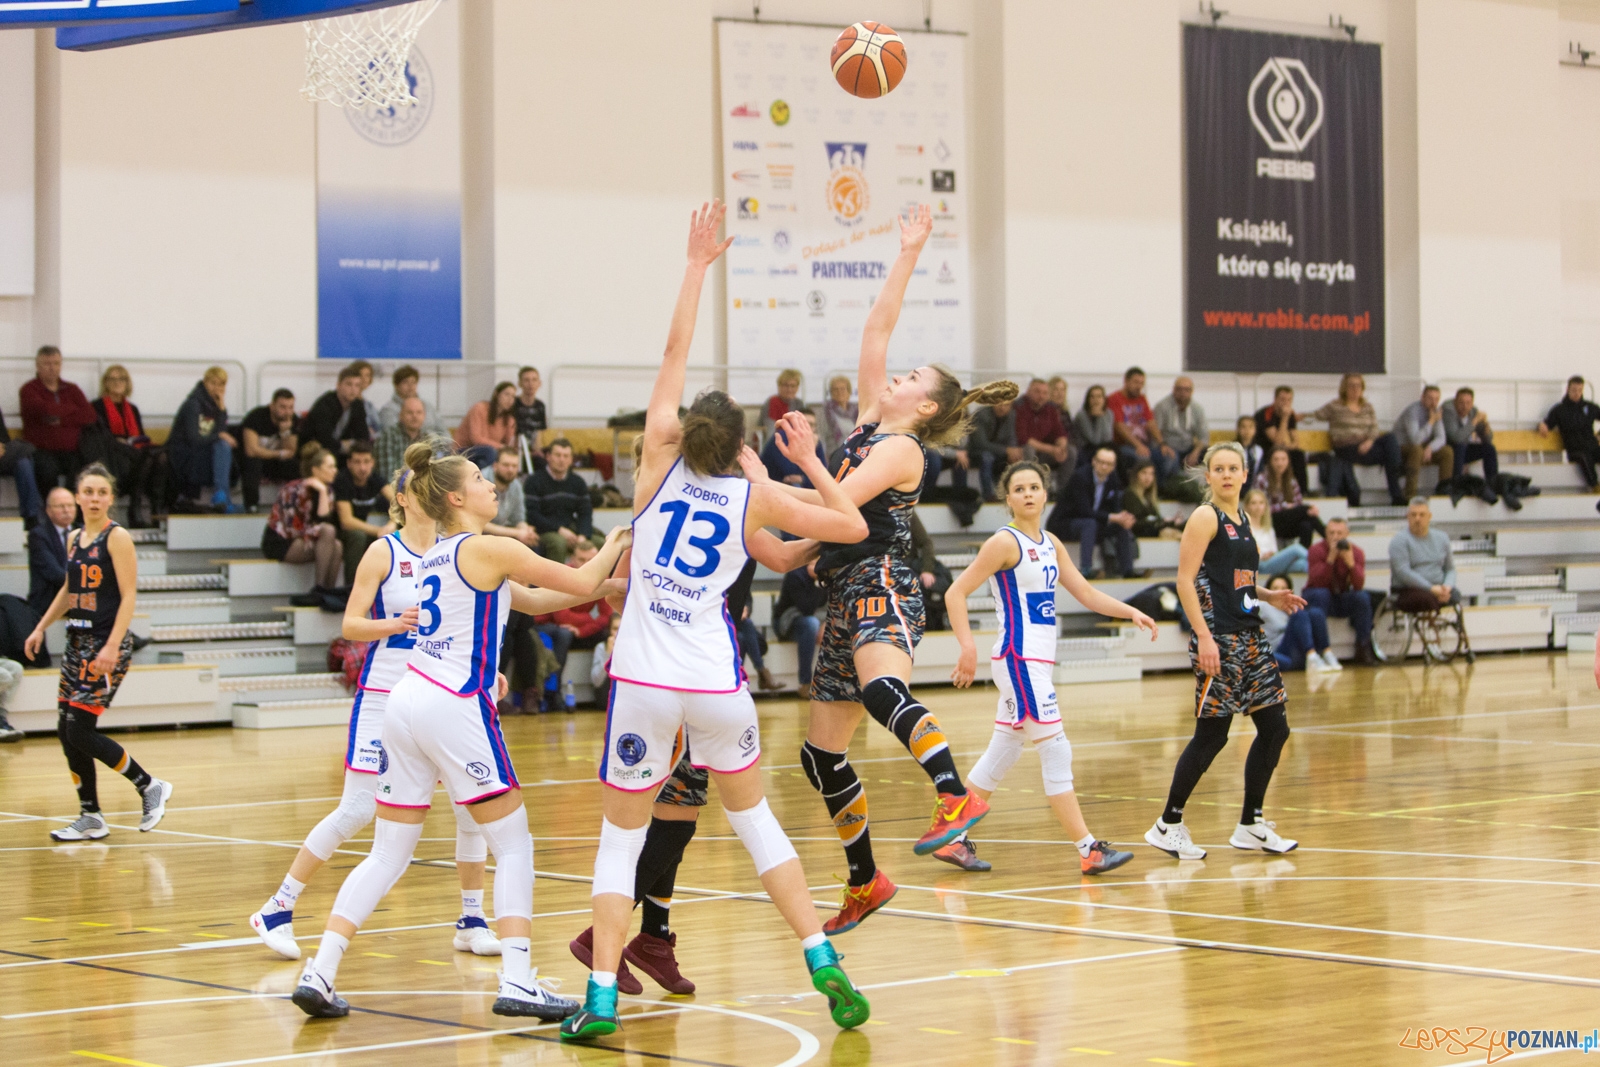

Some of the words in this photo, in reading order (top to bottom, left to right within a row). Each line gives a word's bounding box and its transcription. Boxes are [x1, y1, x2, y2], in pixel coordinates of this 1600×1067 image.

[1257, 157, 1315, 181] REBIS
[1217, 217, 1293, 247] Książki,
[812, 260, 888, 279] PARTNERZY:
[1217, 253, 1269, 278] które
[1273, 255, 1302, 284] się
[1305, 260, 1356, 286] czyta
[1203, 308, 1370, 335] www.rebis.com.pl
[681, 482, 729, 506] ZIOBRO
[655, 500, 731, 578] 13
[79, 563, 103, 589] 19
[1042, 565, 1058, 590] 12
[855, 596, 887, 620] 10
